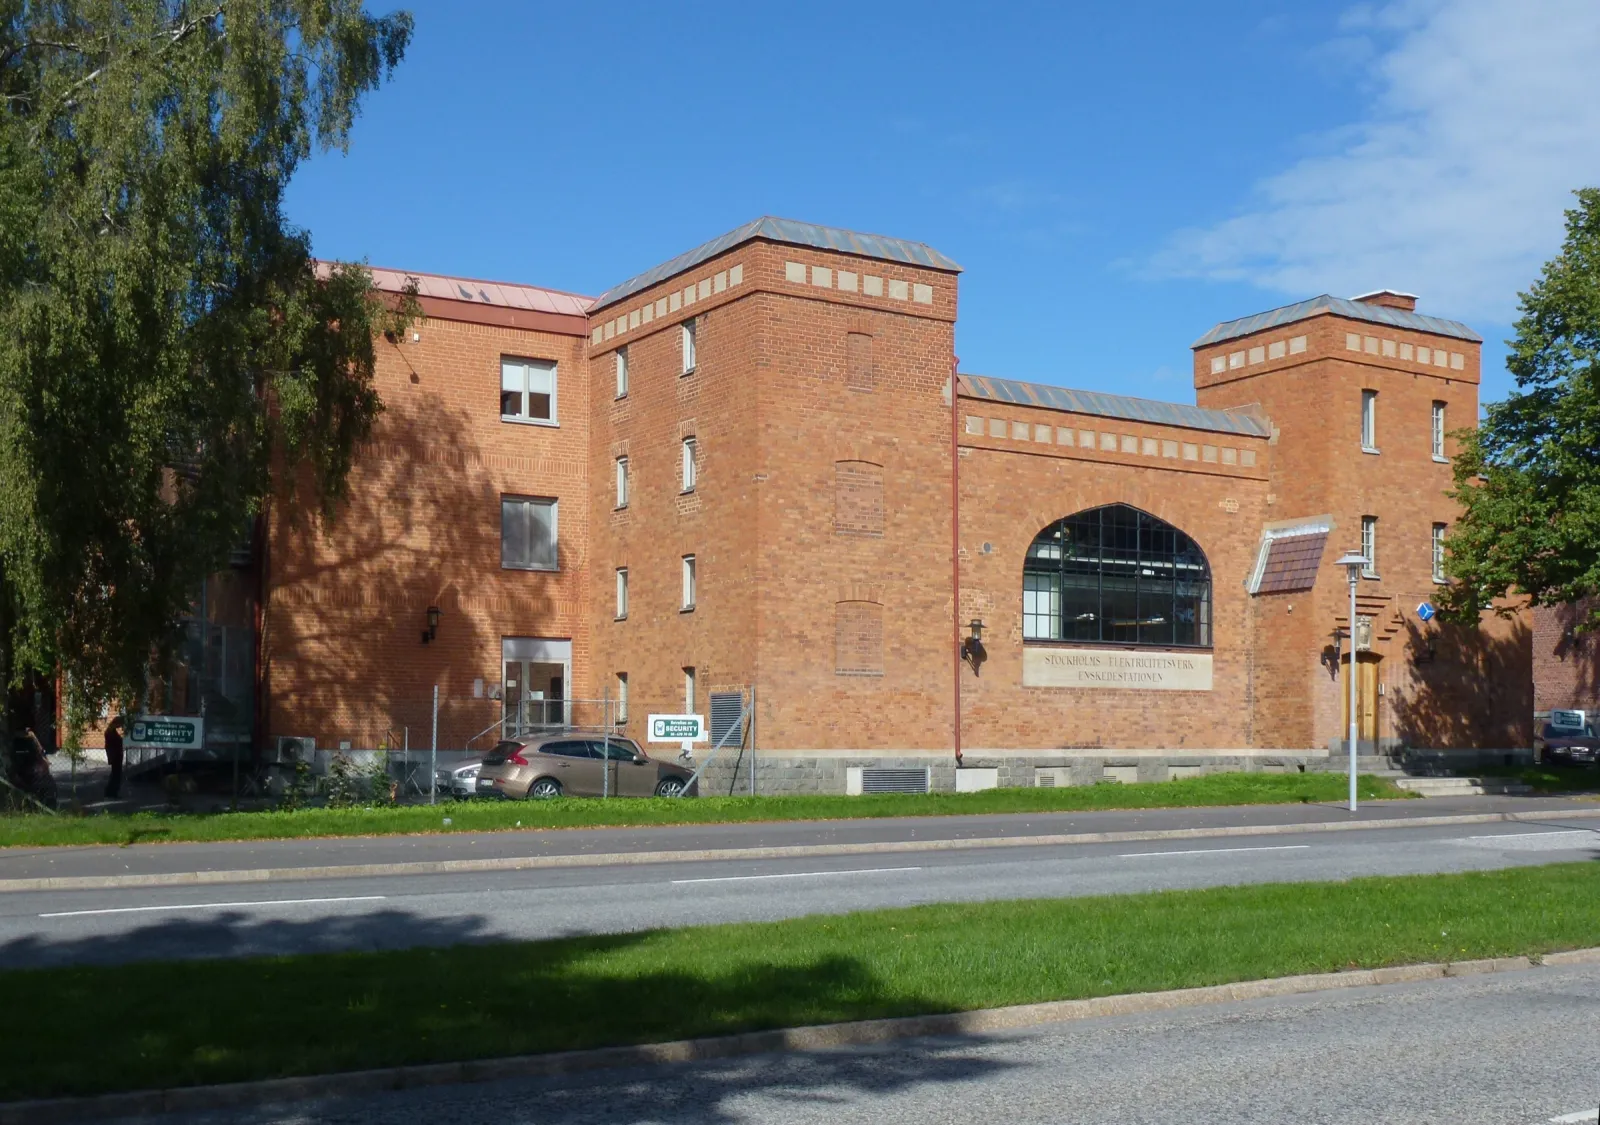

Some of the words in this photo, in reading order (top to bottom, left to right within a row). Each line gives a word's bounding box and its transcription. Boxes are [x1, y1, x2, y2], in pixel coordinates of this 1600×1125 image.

[1044, 655, 1101, 667] STOCKHOLMS
[1109, 656, 1194, 670] ELEKTRICITETSVERK
[1078, 671, 1163, 683] ENSKEDESTATIONEN
[147, 728, 193, 737] SECURITY
